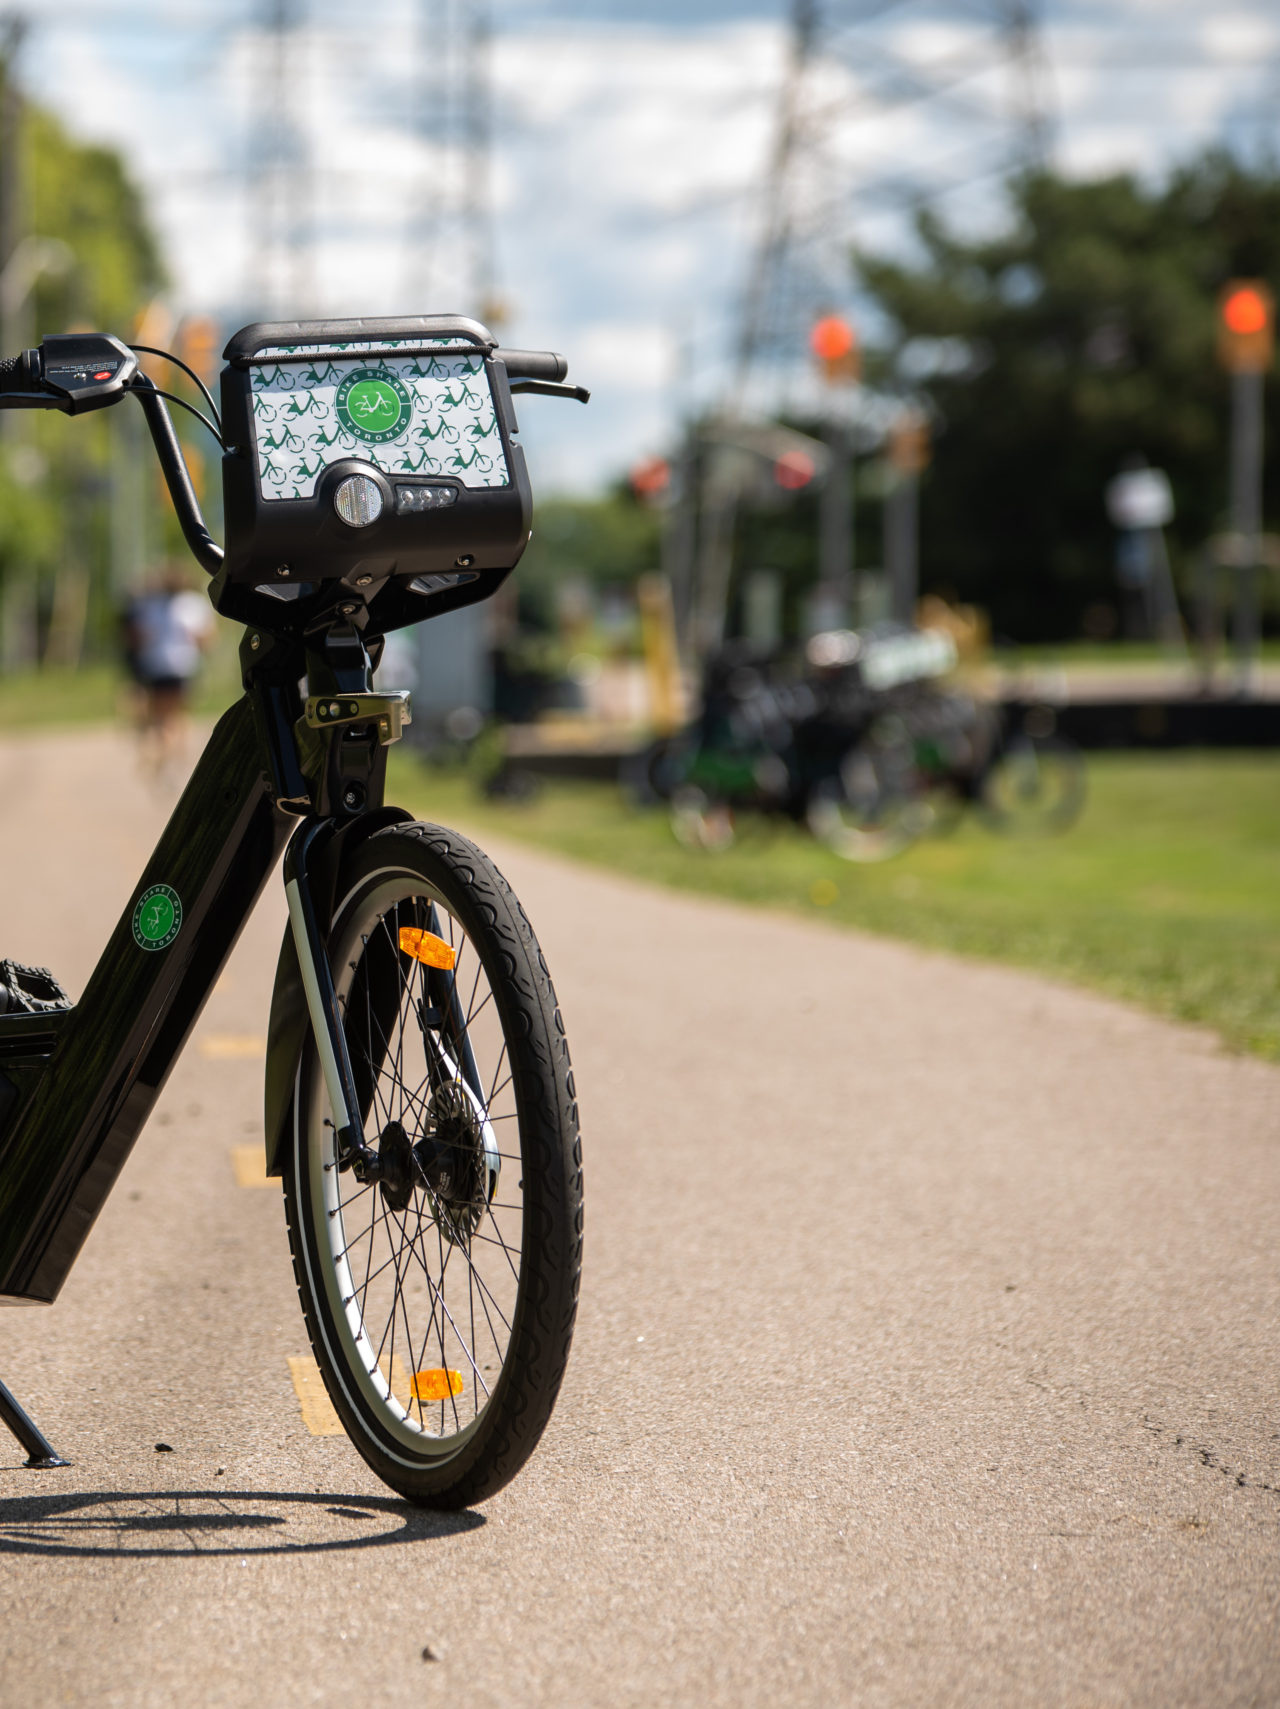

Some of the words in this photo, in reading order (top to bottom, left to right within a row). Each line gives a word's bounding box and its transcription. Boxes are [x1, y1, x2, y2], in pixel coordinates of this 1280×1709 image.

[339, 374, 359, 400] BIKE
[367, 371, 406, 397] SHARE
[347, 418, 407, 440] TORONTO
[140, 887, 166, 906] SHARE
[152, 901, 180, 948] TORONTO
